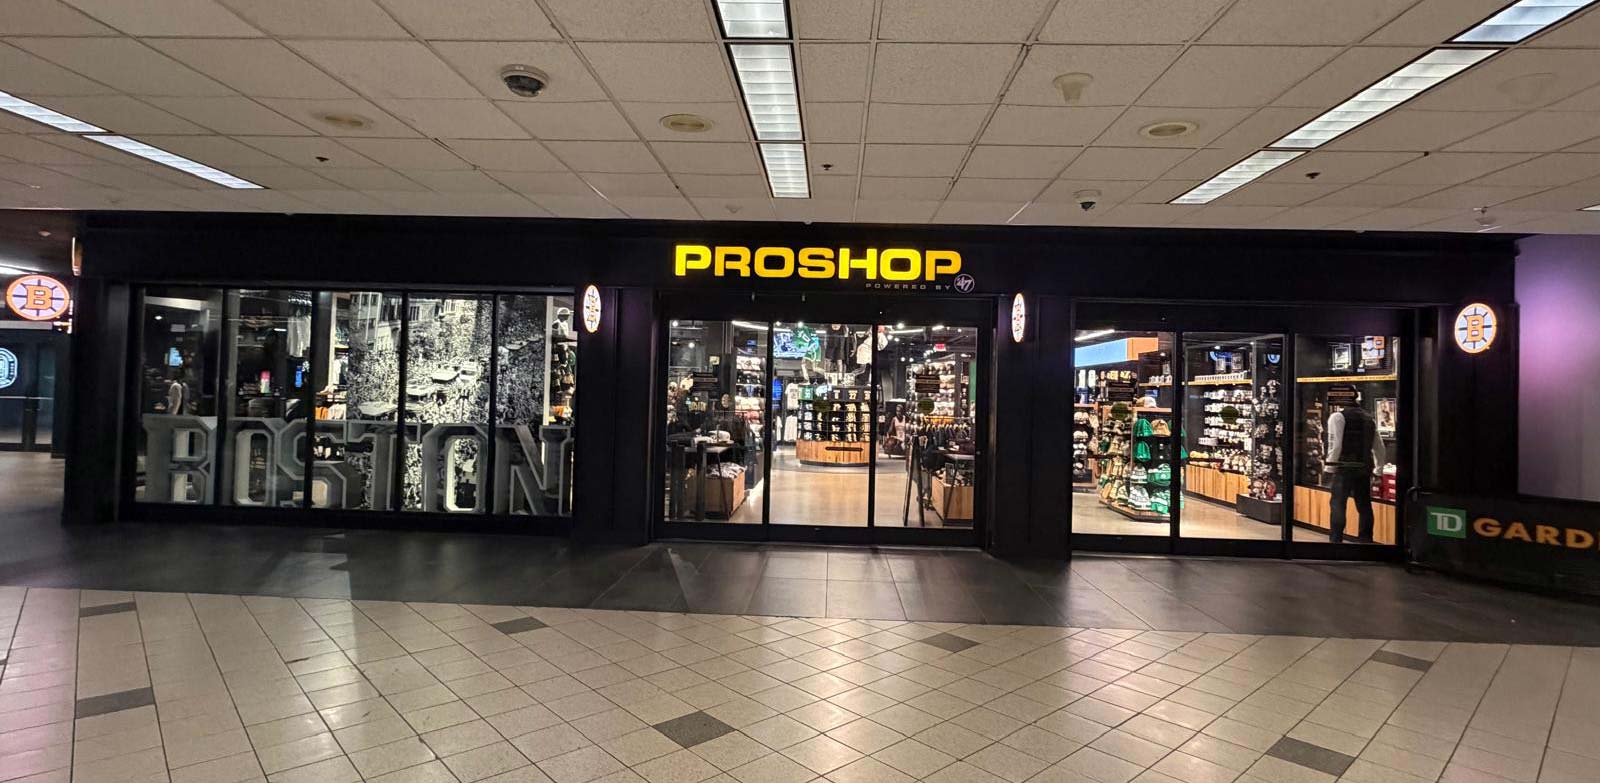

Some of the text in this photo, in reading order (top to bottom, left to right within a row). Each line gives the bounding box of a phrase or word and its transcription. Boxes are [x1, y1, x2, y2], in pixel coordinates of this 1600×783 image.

[675, 245, 962, 281] PROSHOP
[143, 415, 572, 514] BOSTON
[1430, 512, 1600, 551] TD GARD
